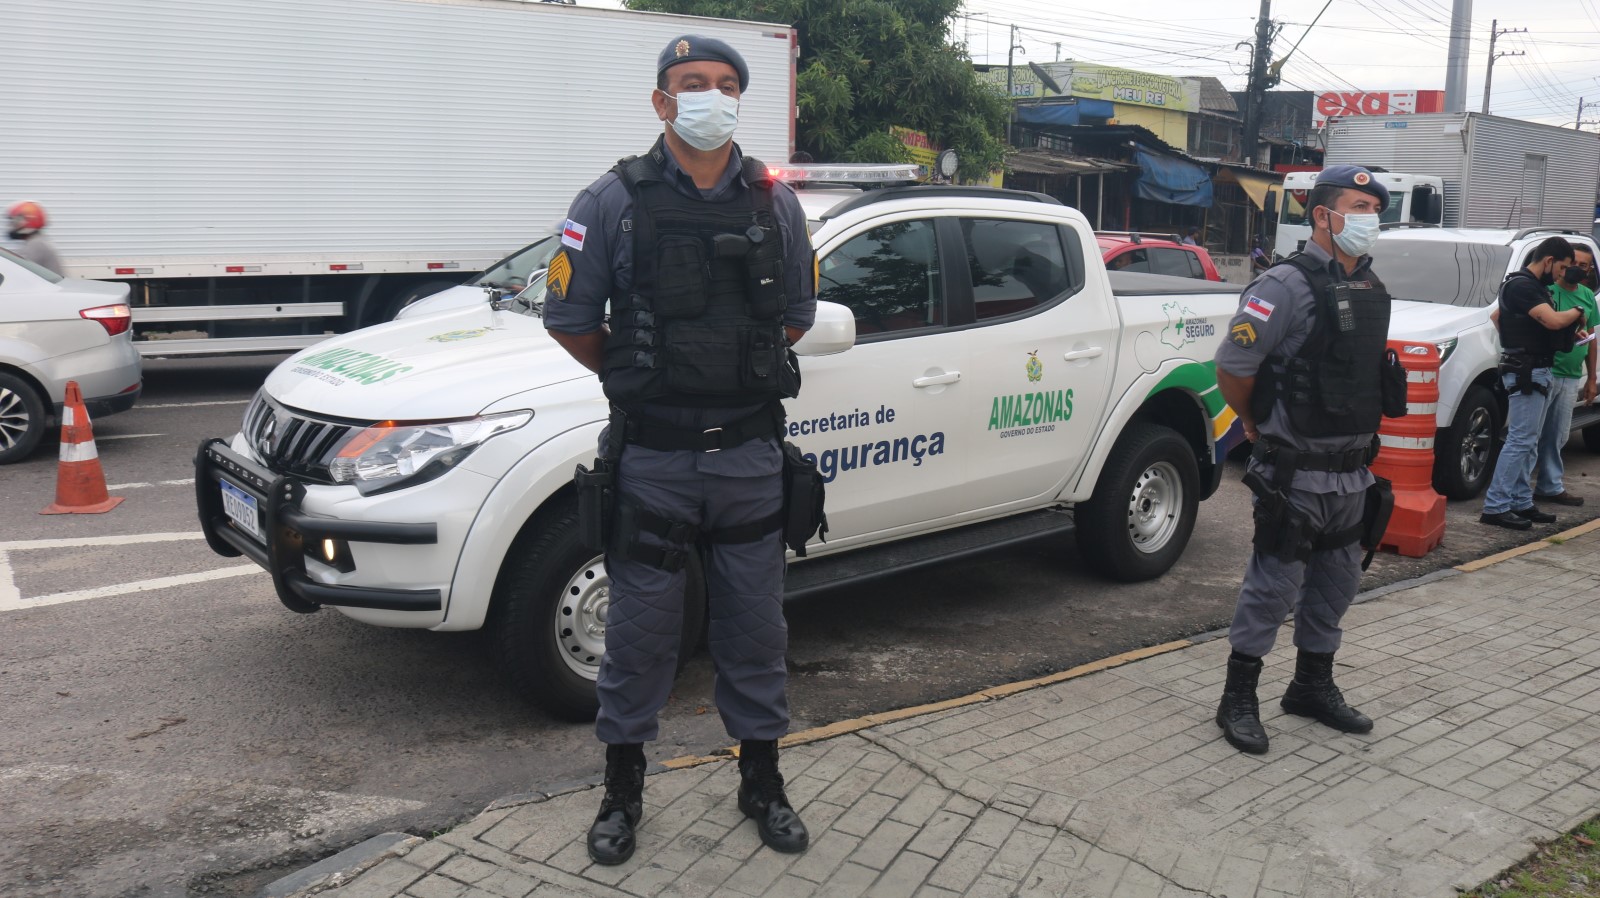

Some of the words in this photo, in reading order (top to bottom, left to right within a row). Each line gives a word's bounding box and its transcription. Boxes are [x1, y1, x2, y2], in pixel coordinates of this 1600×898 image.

[1113, 86, 1142, 102] MEU
[1145, 89, 1166, 105] REI
[1316, 92, 1389, 116] exa
[1186, 325, 1214, 338] SEGURO
[294, 347, 414, 386] AMAZONAS
[875, 404, 896, 425] de
[988, 388, 1074, 431] AMAZONAS
[1000, 428, 1026, 439] GOVERNO
[1026, 427, 1035, 435] DO
[1035, 424, 1056, 434] ESTADO
